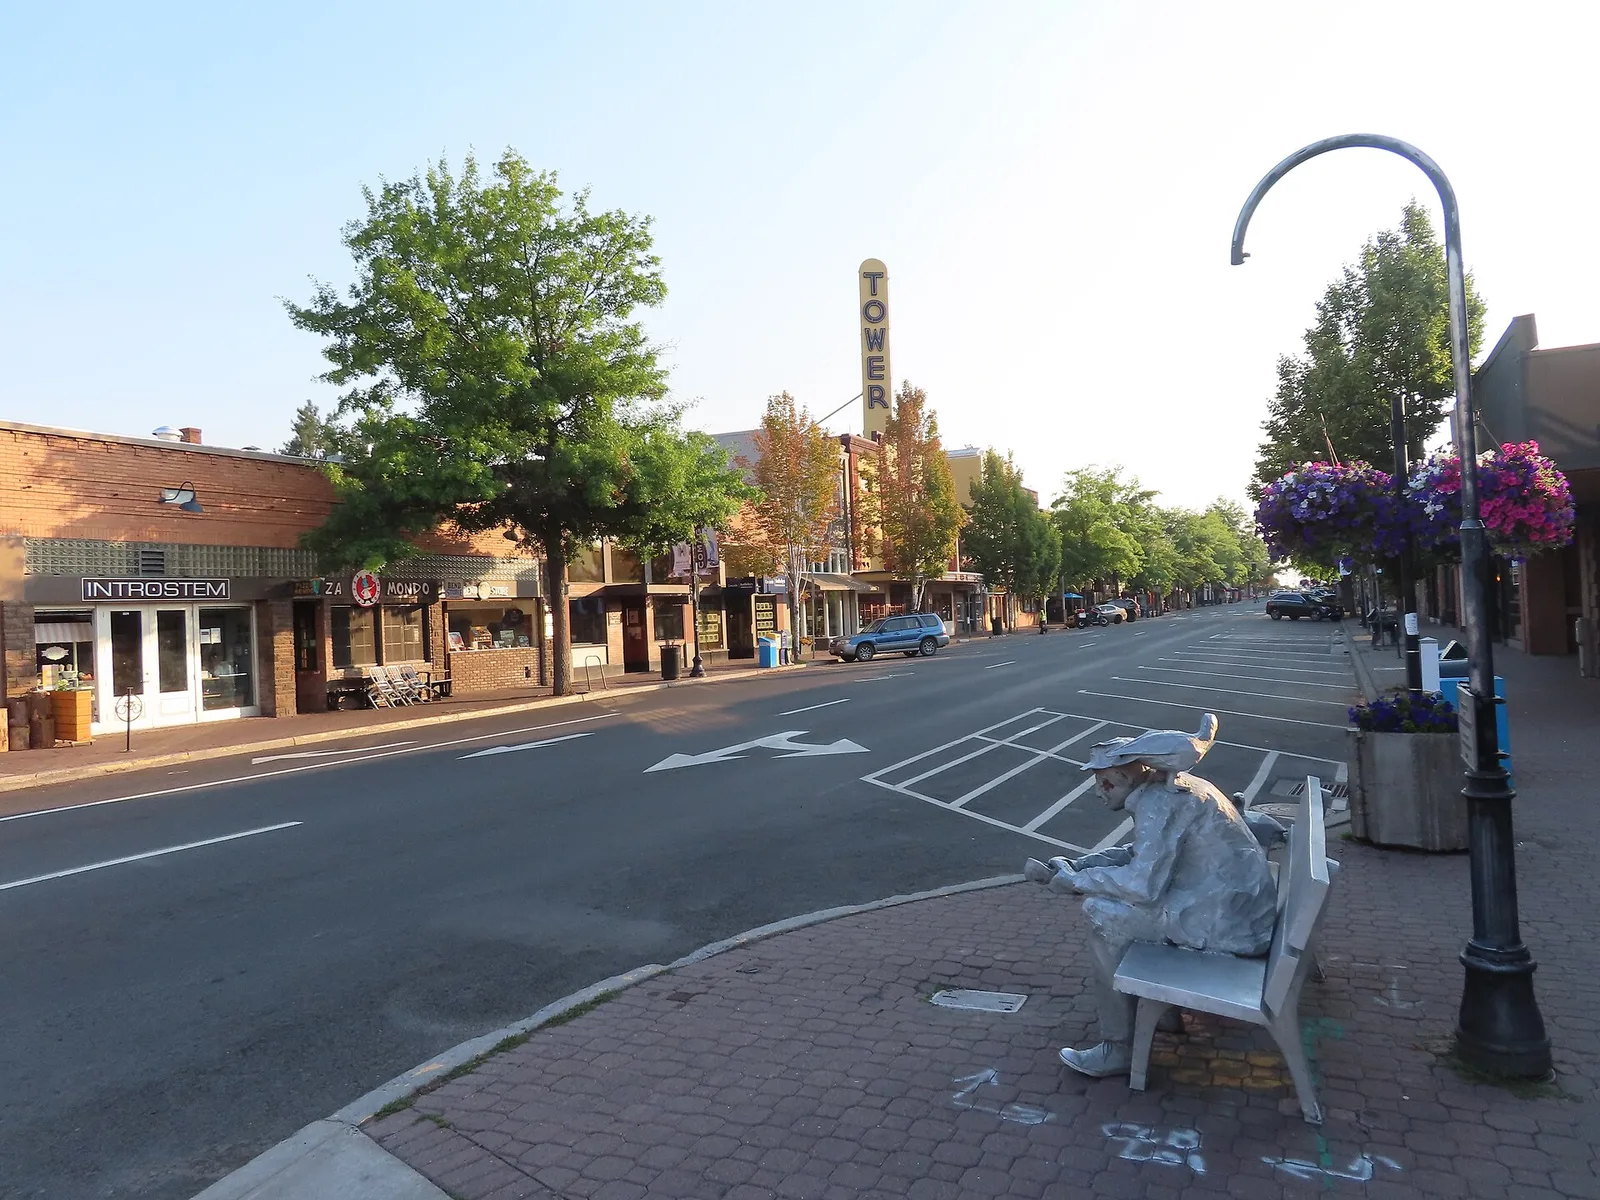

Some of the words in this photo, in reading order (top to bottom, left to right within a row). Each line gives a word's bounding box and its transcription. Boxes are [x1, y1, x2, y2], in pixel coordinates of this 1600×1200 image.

[862, 271, 889, 410] TOWER
[87, 581, 226, 597] INTROSTEM
[386, 581, 430, 596] MONDO
